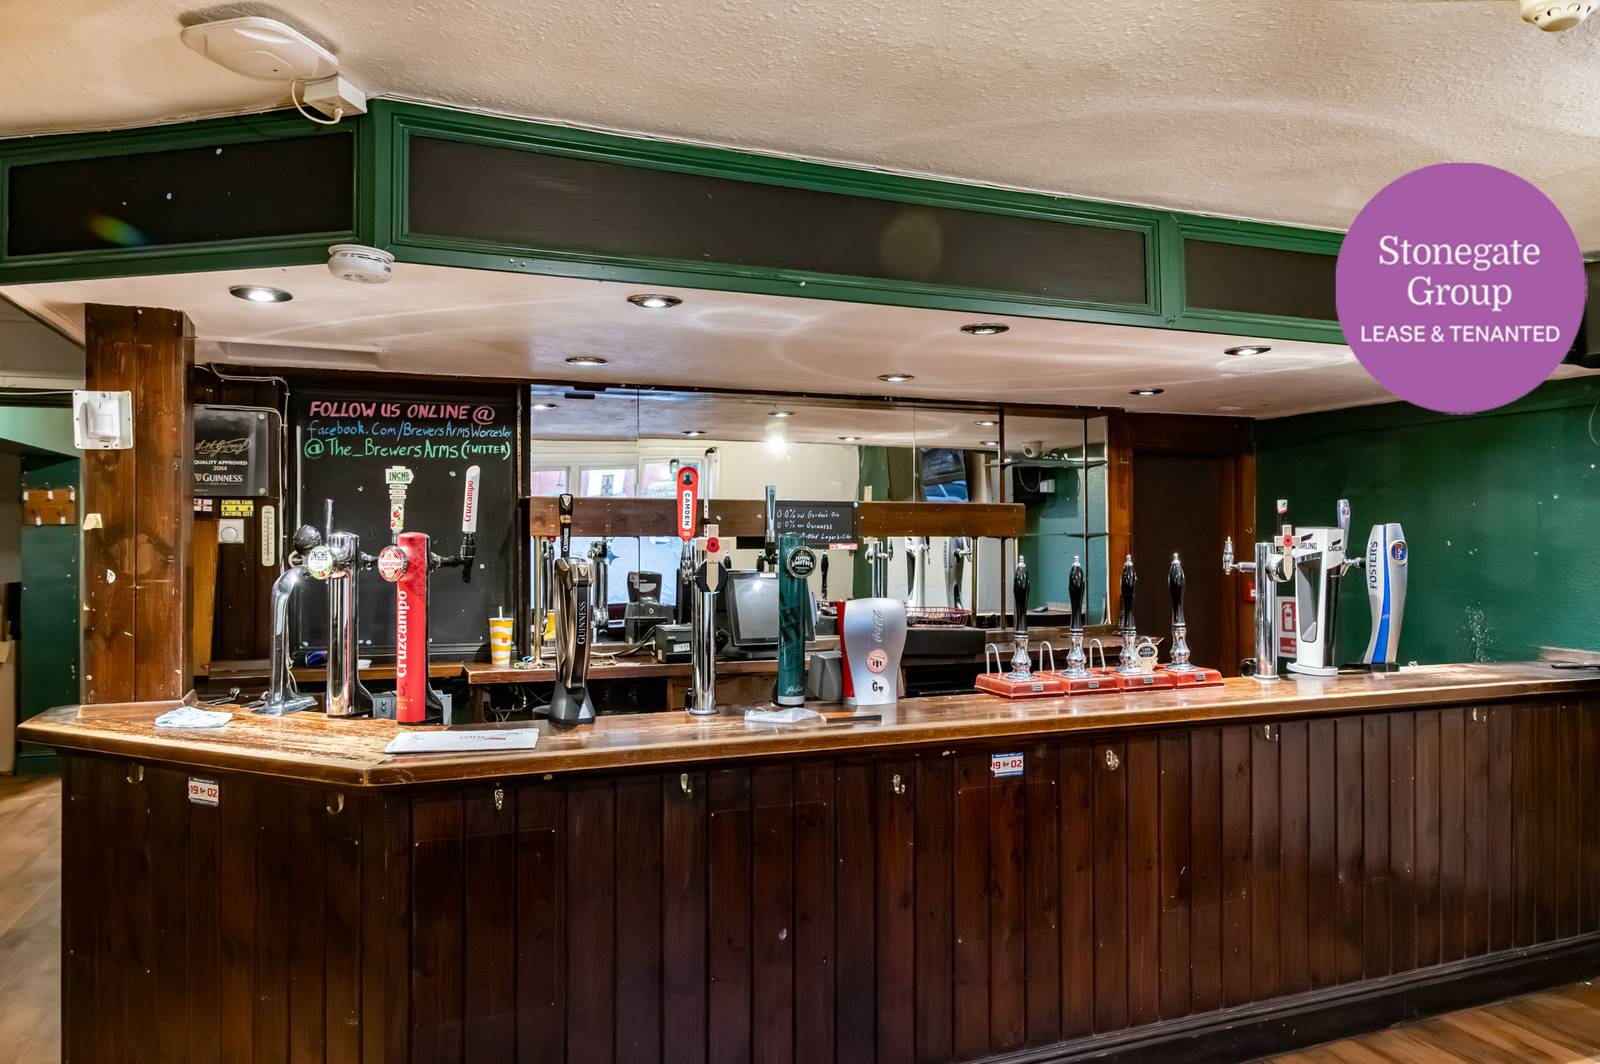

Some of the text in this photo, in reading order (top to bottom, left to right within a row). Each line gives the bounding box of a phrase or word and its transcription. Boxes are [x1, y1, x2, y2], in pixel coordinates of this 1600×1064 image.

[309, 401, 496, 426] FOLLOW US ONLINE @
[460, 440, 511, 460] (TWITTER)
[1299, 541, 1318, 550] ARLING
[396, 590, 410, 678] Cruzcampo
[1011, 760, 1022, 768] 02
[207, 788, 218, 798] 02
